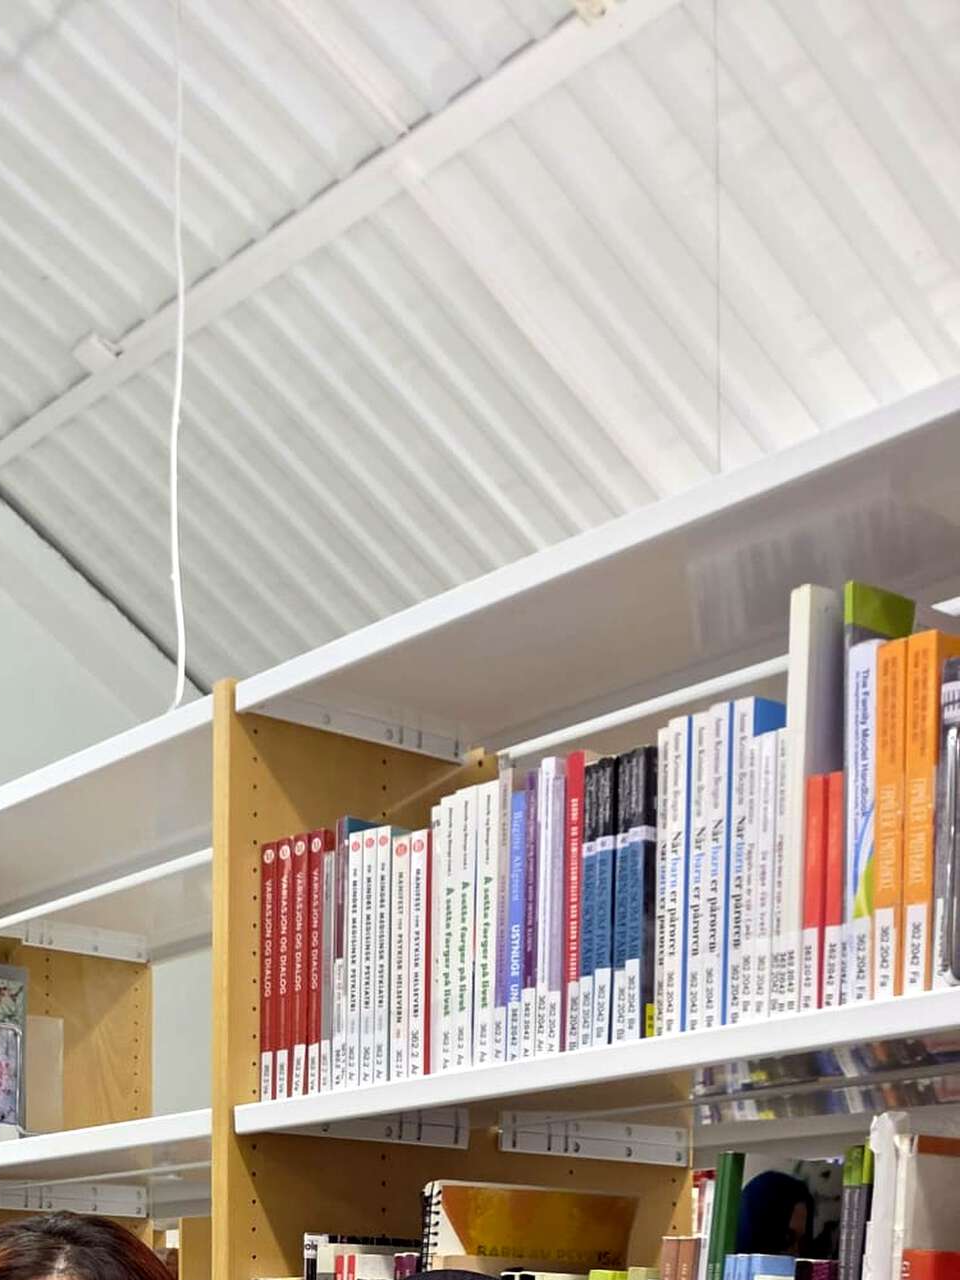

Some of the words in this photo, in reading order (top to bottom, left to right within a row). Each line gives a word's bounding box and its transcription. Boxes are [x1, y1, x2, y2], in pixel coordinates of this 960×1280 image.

[861, 670, 870, 689] The
[858, 691, 869, 724] Family
[860, 727, 870, 761] Model
[860, 764, 869, 817] Handbook
[670, 858, 682, 887] barn
[693, 853, 706, 884] barn
[710, 845, 723, 876] barn
[734, 840, 746, 873] barn
[311, 869, 319, 928] VARIASJON
[669, 890, 677, 905] er
[693, 886, 701, 902] er
[710, 879, 718, 895] er
[733, 876, 742, 891] er
[265, 937, 271, 954] OG
[280, 937, 287, 952] OG
[295, 933, 302, 949] OG
[311, 931, 318, 947] OG
[364, 914, 372, 961] MEDISINSK
[443, 932, 453, 969] farger
[458, 926, 468, 964] farger
[481, 920, 491, 959] farger
[880, 926, 891, 970] 362.2042
[911, 922, 922, 967] 362.2042
[481, 963, 491, 979] på
[856, 934, 867, 980] 362.2042
[377, 964, 385, 1008] PSYKIATRI
[443, 972, 453, 988] på
[458, 967, 468, 983] på
[705, 967, 714, 1009] 362.2042
[730, 965, 740, 1008] 362.2042
[742, 955, 751, 995] 362.2042
[756, 955, 766, 995] 362.2042
[443, 989, 452, 1017] livet
[458, 985, 468, 1012] livet
[481, 981, 490, 1009] livet
[666, 971, 675, 1013] 362.2042
[690, 971, 699, 1013] 362.2042
[537, 995, 546, 1034] 362.2042
